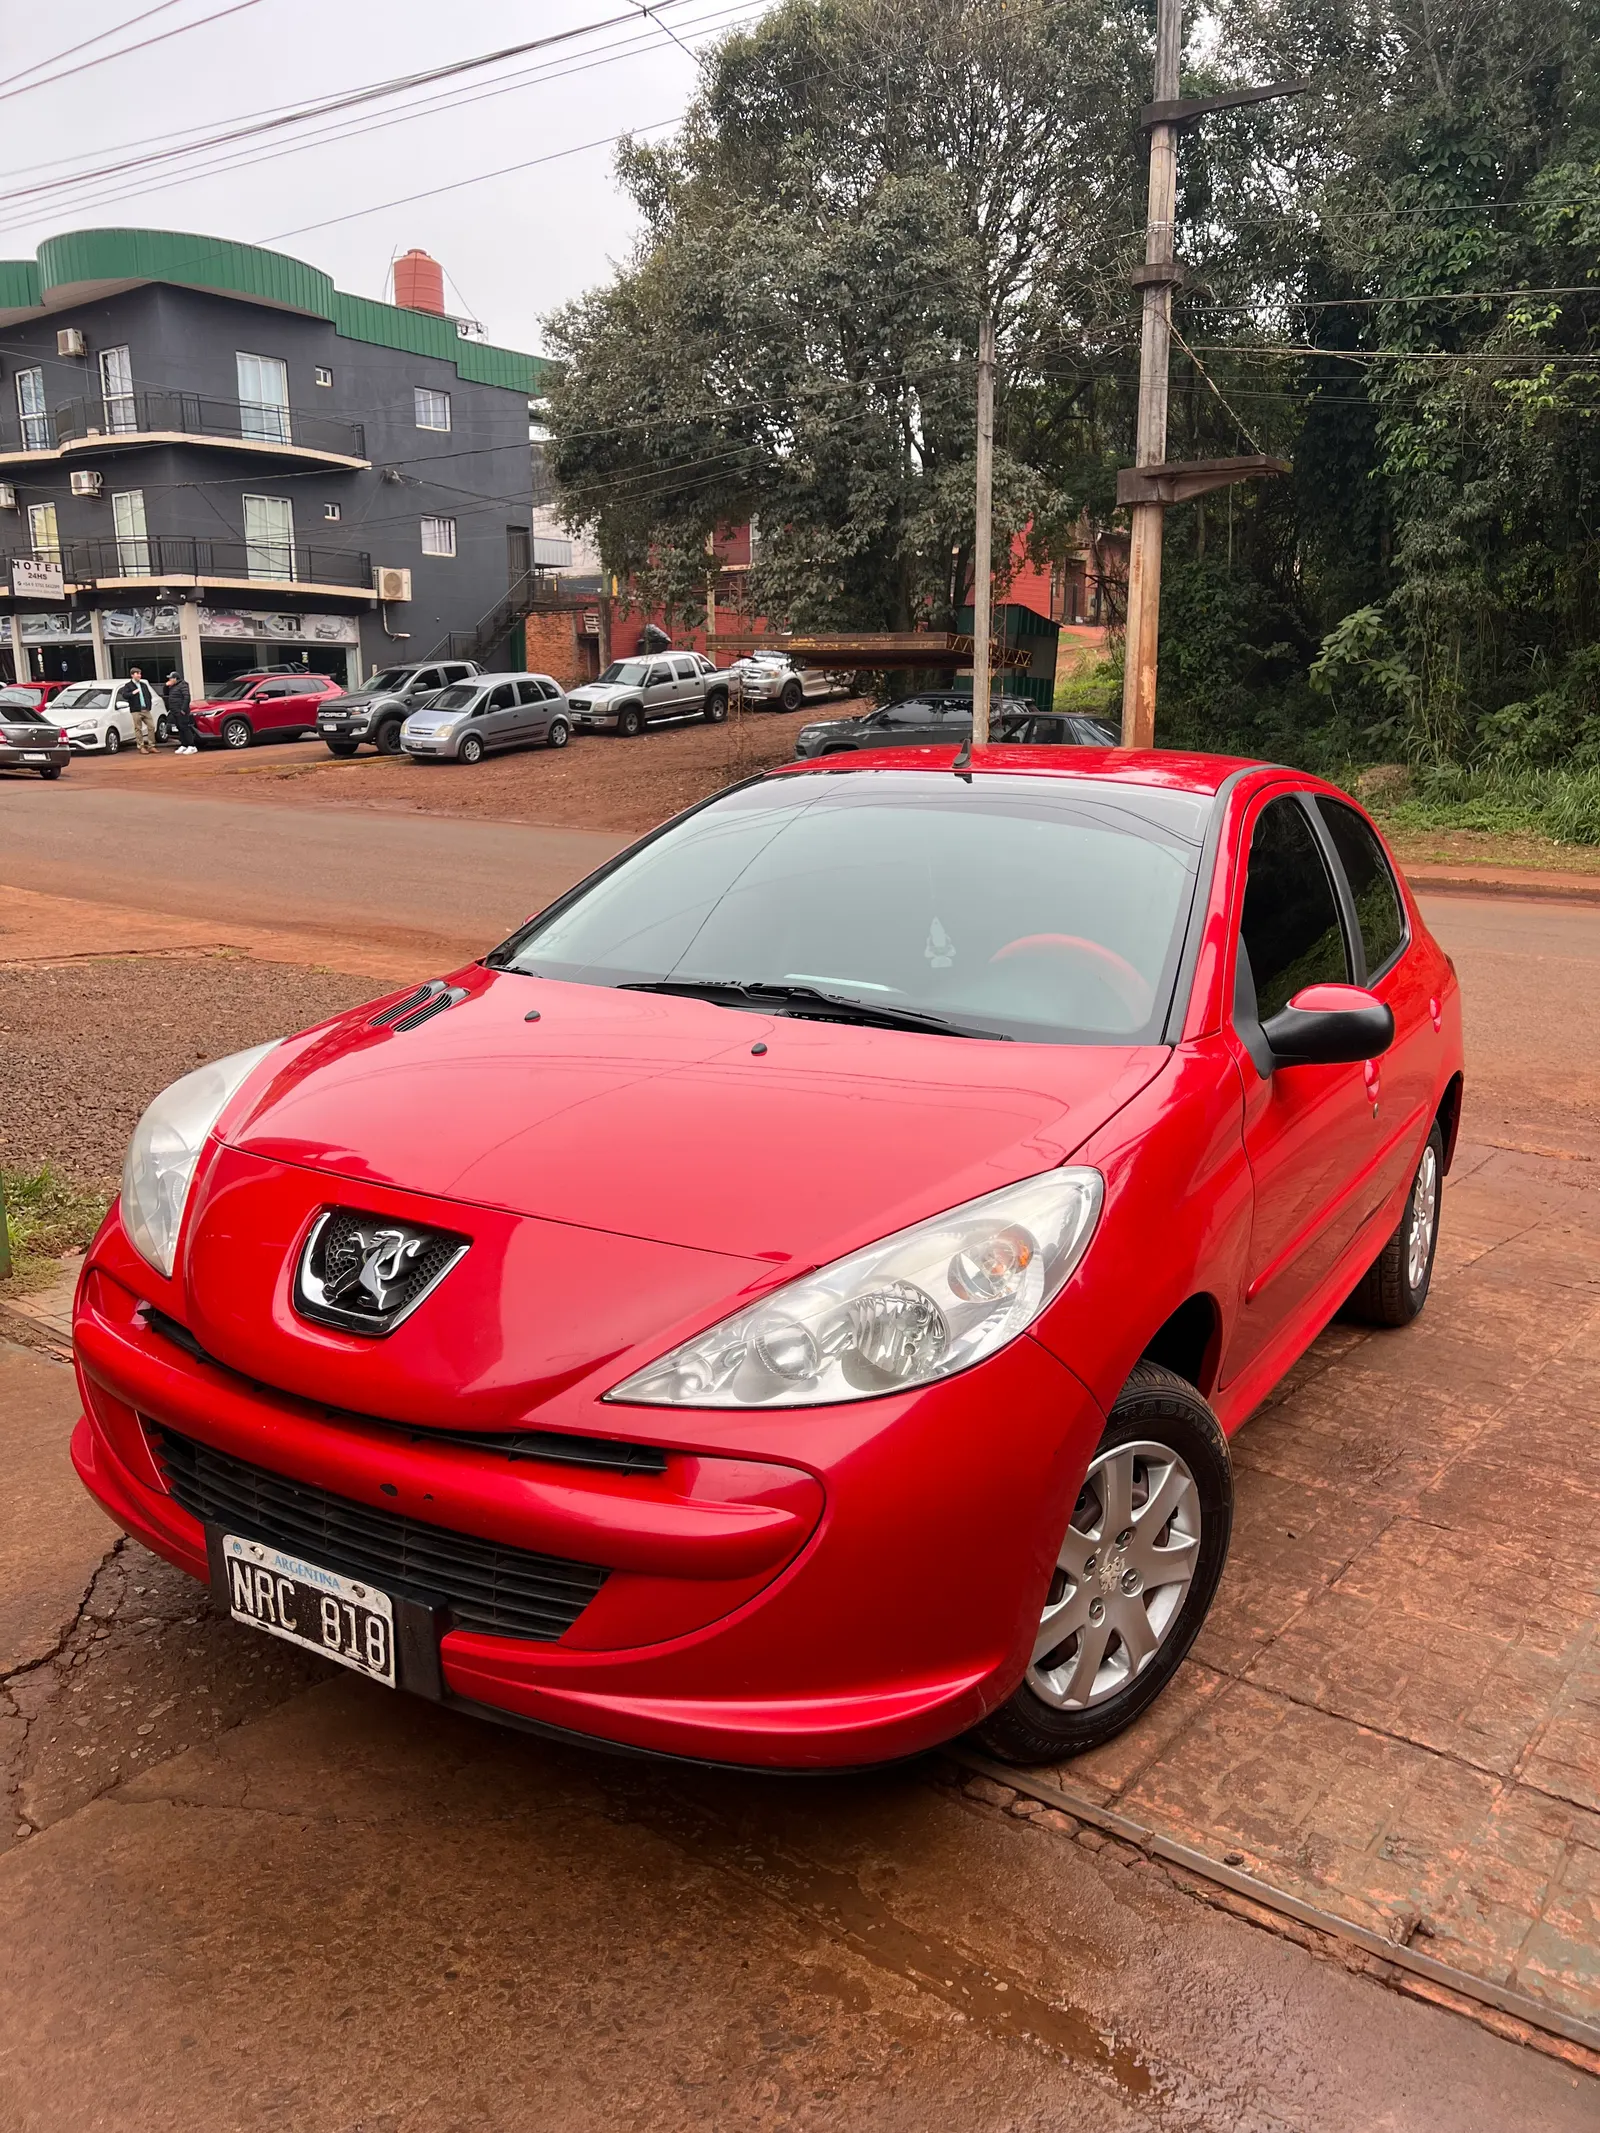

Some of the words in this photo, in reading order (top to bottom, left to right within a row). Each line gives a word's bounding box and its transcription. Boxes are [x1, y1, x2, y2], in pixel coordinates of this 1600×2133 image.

[12, 561, 61, 573] HOTEL
[28, 572, 47, 580] 24HS
[275, 1556, 340, 1588] ARGENTINA
[233, 1562, 297, 1630] NRC
[321, 1596, 386, 1671] 818
